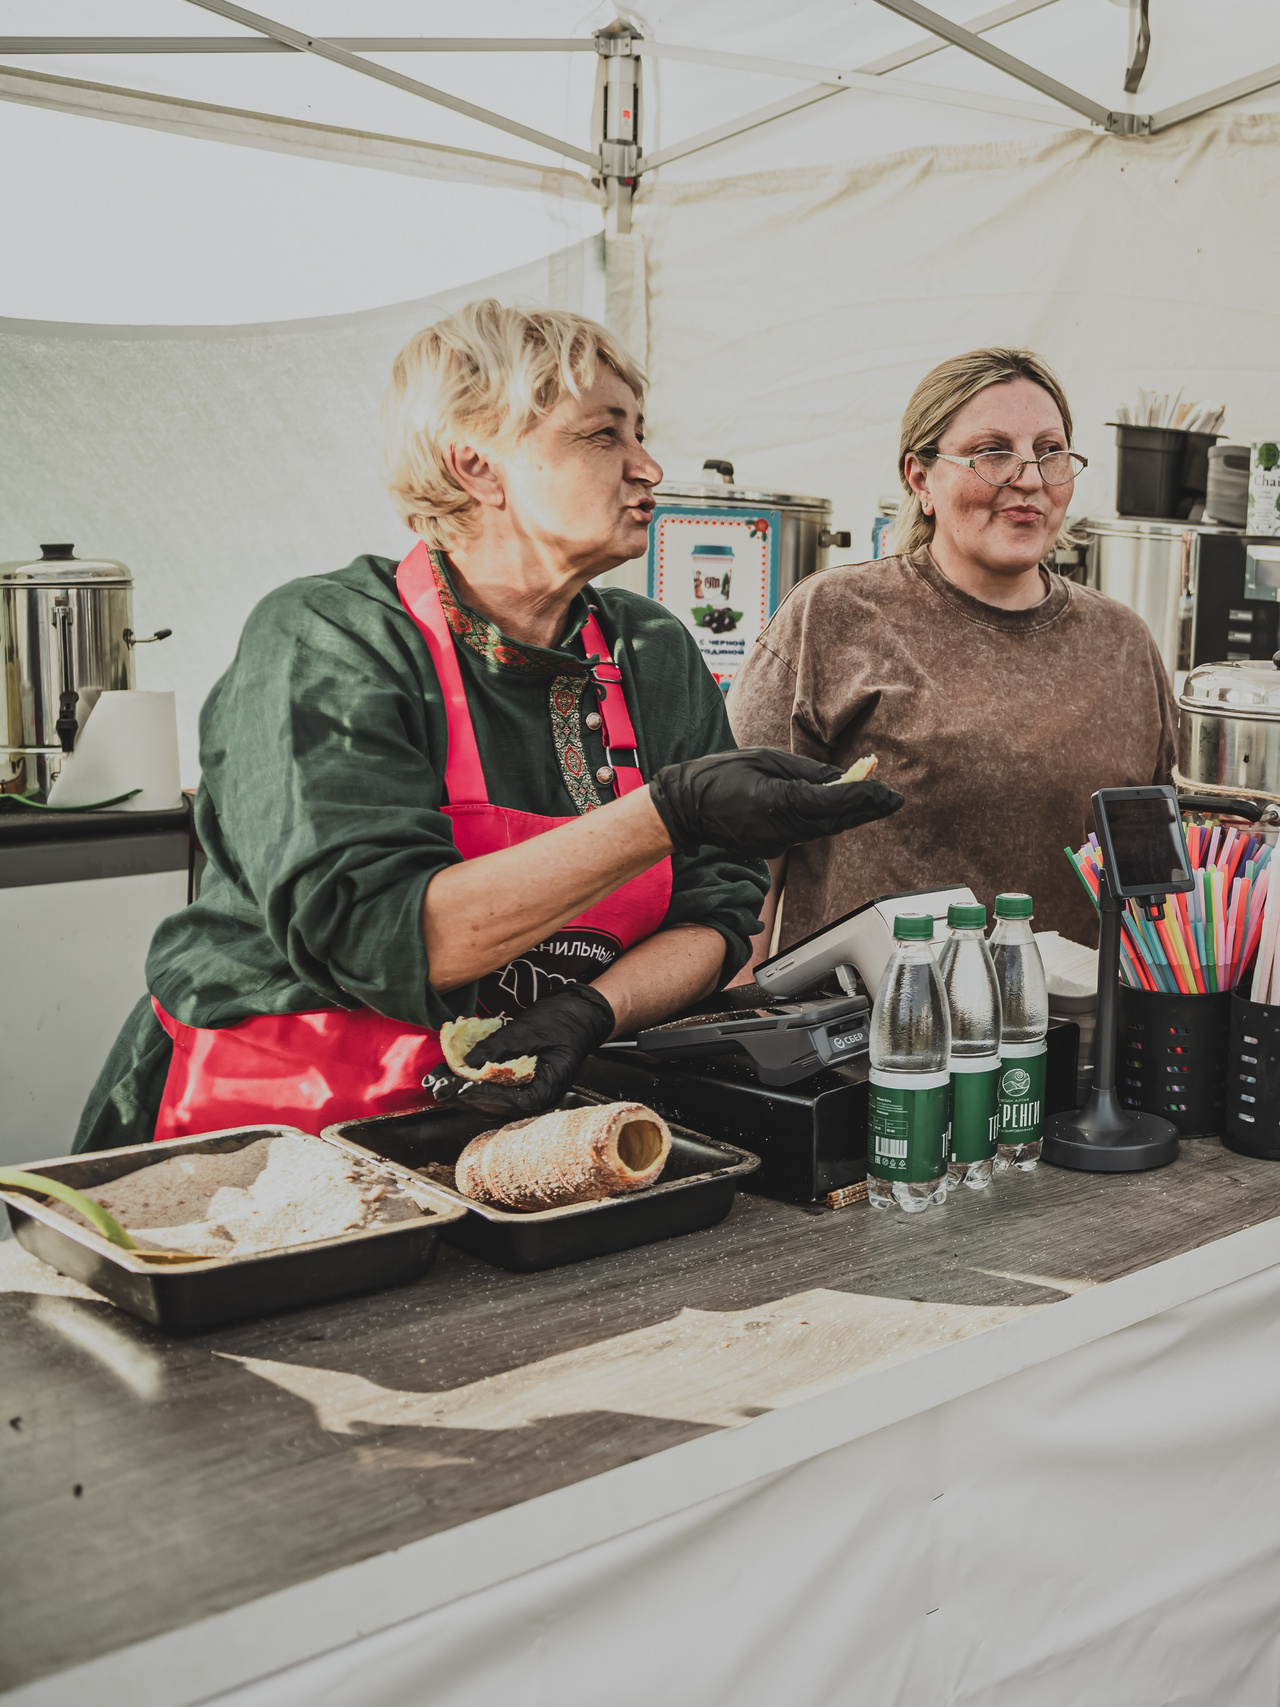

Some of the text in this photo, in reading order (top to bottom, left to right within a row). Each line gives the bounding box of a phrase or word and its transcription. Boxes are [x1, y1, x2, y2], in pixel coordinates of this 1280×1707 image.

[1254, 474, 1280, 488] Chai
[701, 648, 745, 656] ОДИНОЙ
[843, 1032, 864, 1045] СБЕР
[999, 1100, 1040, 1128] РЕНГИ
